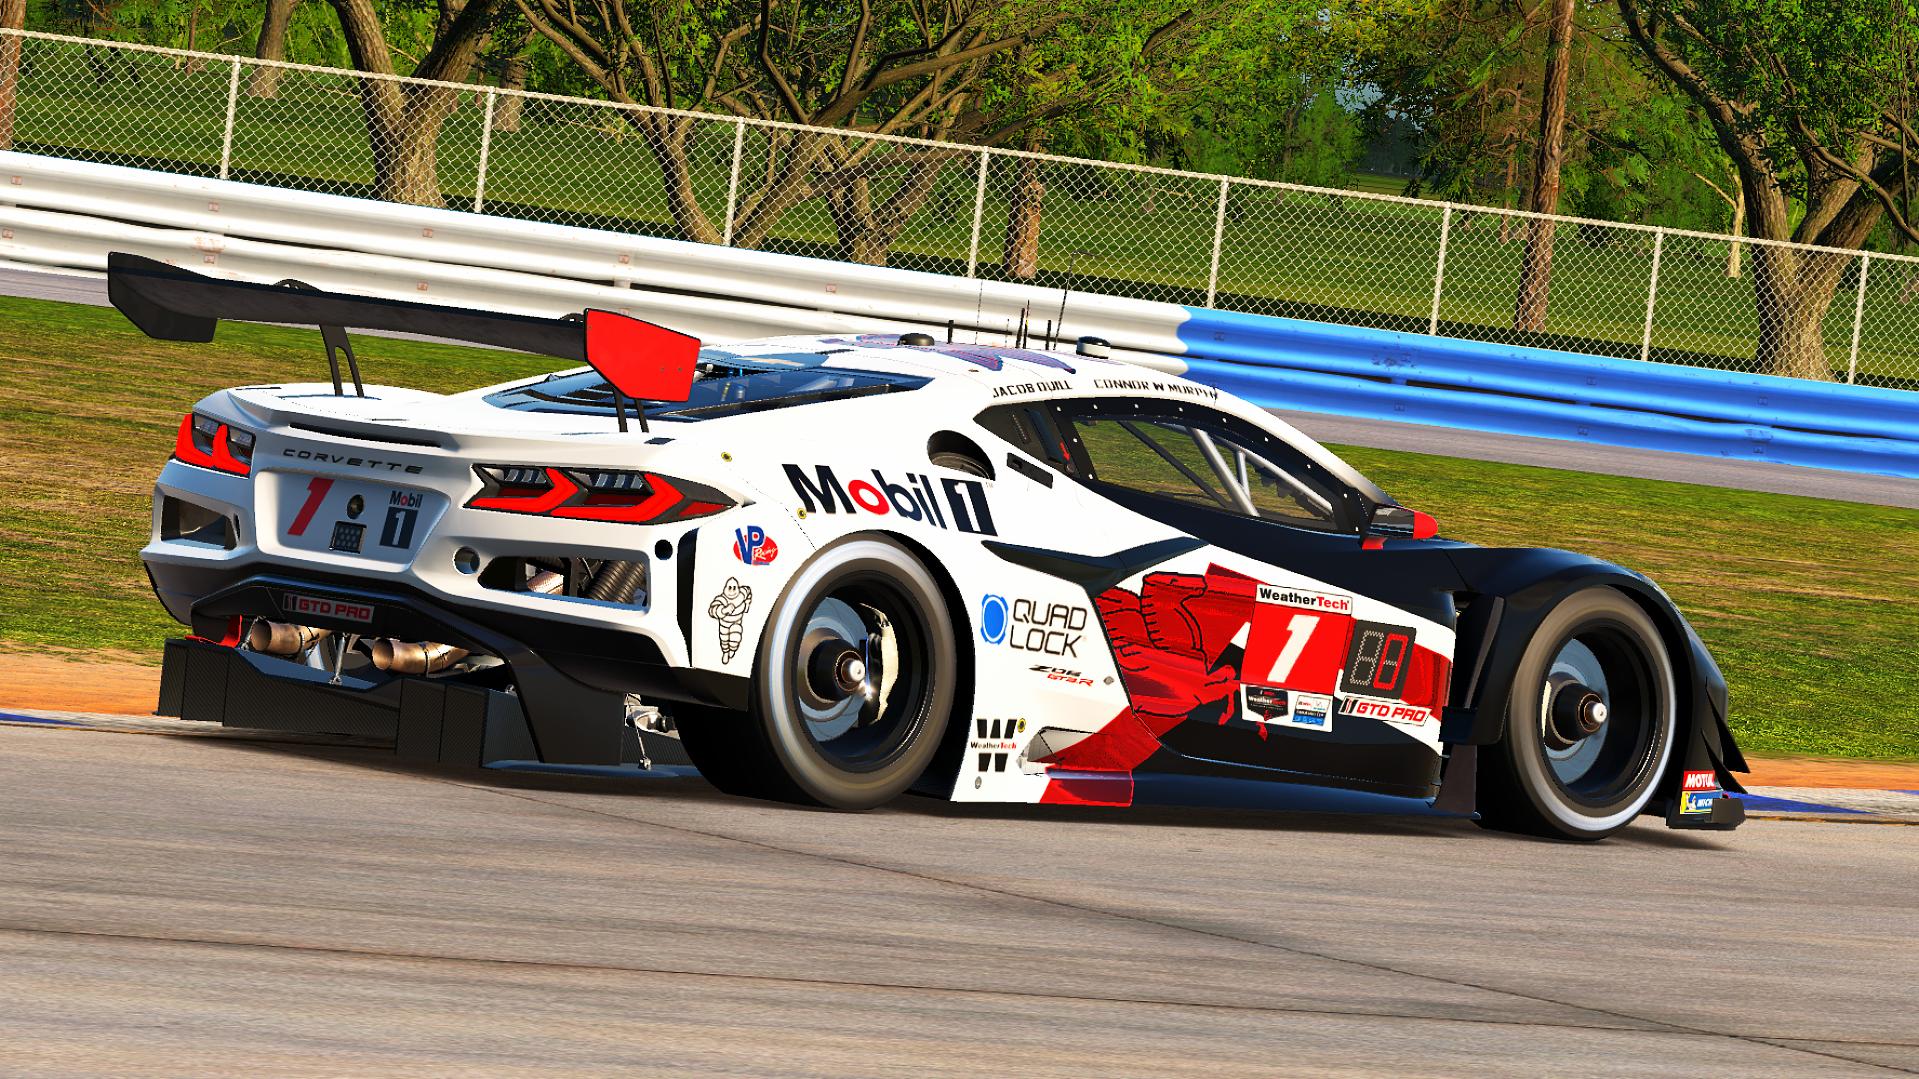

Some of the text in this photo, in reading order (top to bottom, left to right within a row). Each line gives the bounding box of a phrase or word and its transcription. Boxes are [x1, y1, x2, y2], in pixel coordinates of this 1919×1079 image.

[993, 384, 1035, 398] JACOB
[1093, 378, 1149, 391] CONNOR
[1153, 381, 1165, 392] W
[283, 449, 424, 475] CORVETTE
[288, 477, 335, 536] 1
[389, 490, 423, 508] Mobil
[781, 463, 948, 531] Mobil
[735, 525, 765, 564] VP
[298, 598, 371, 620] GTD PRO
[1259, 587, 1349, 610] WeatherTech
[1013, 598, 1088, 631] QUAD
[1009, 624, 1082, 659] LOCK
[1266, 613, 1321, 684] 1
[1356, 702, 1428, 723] GTD PRO
[1684, 773, 1715, 788] MOTUL
